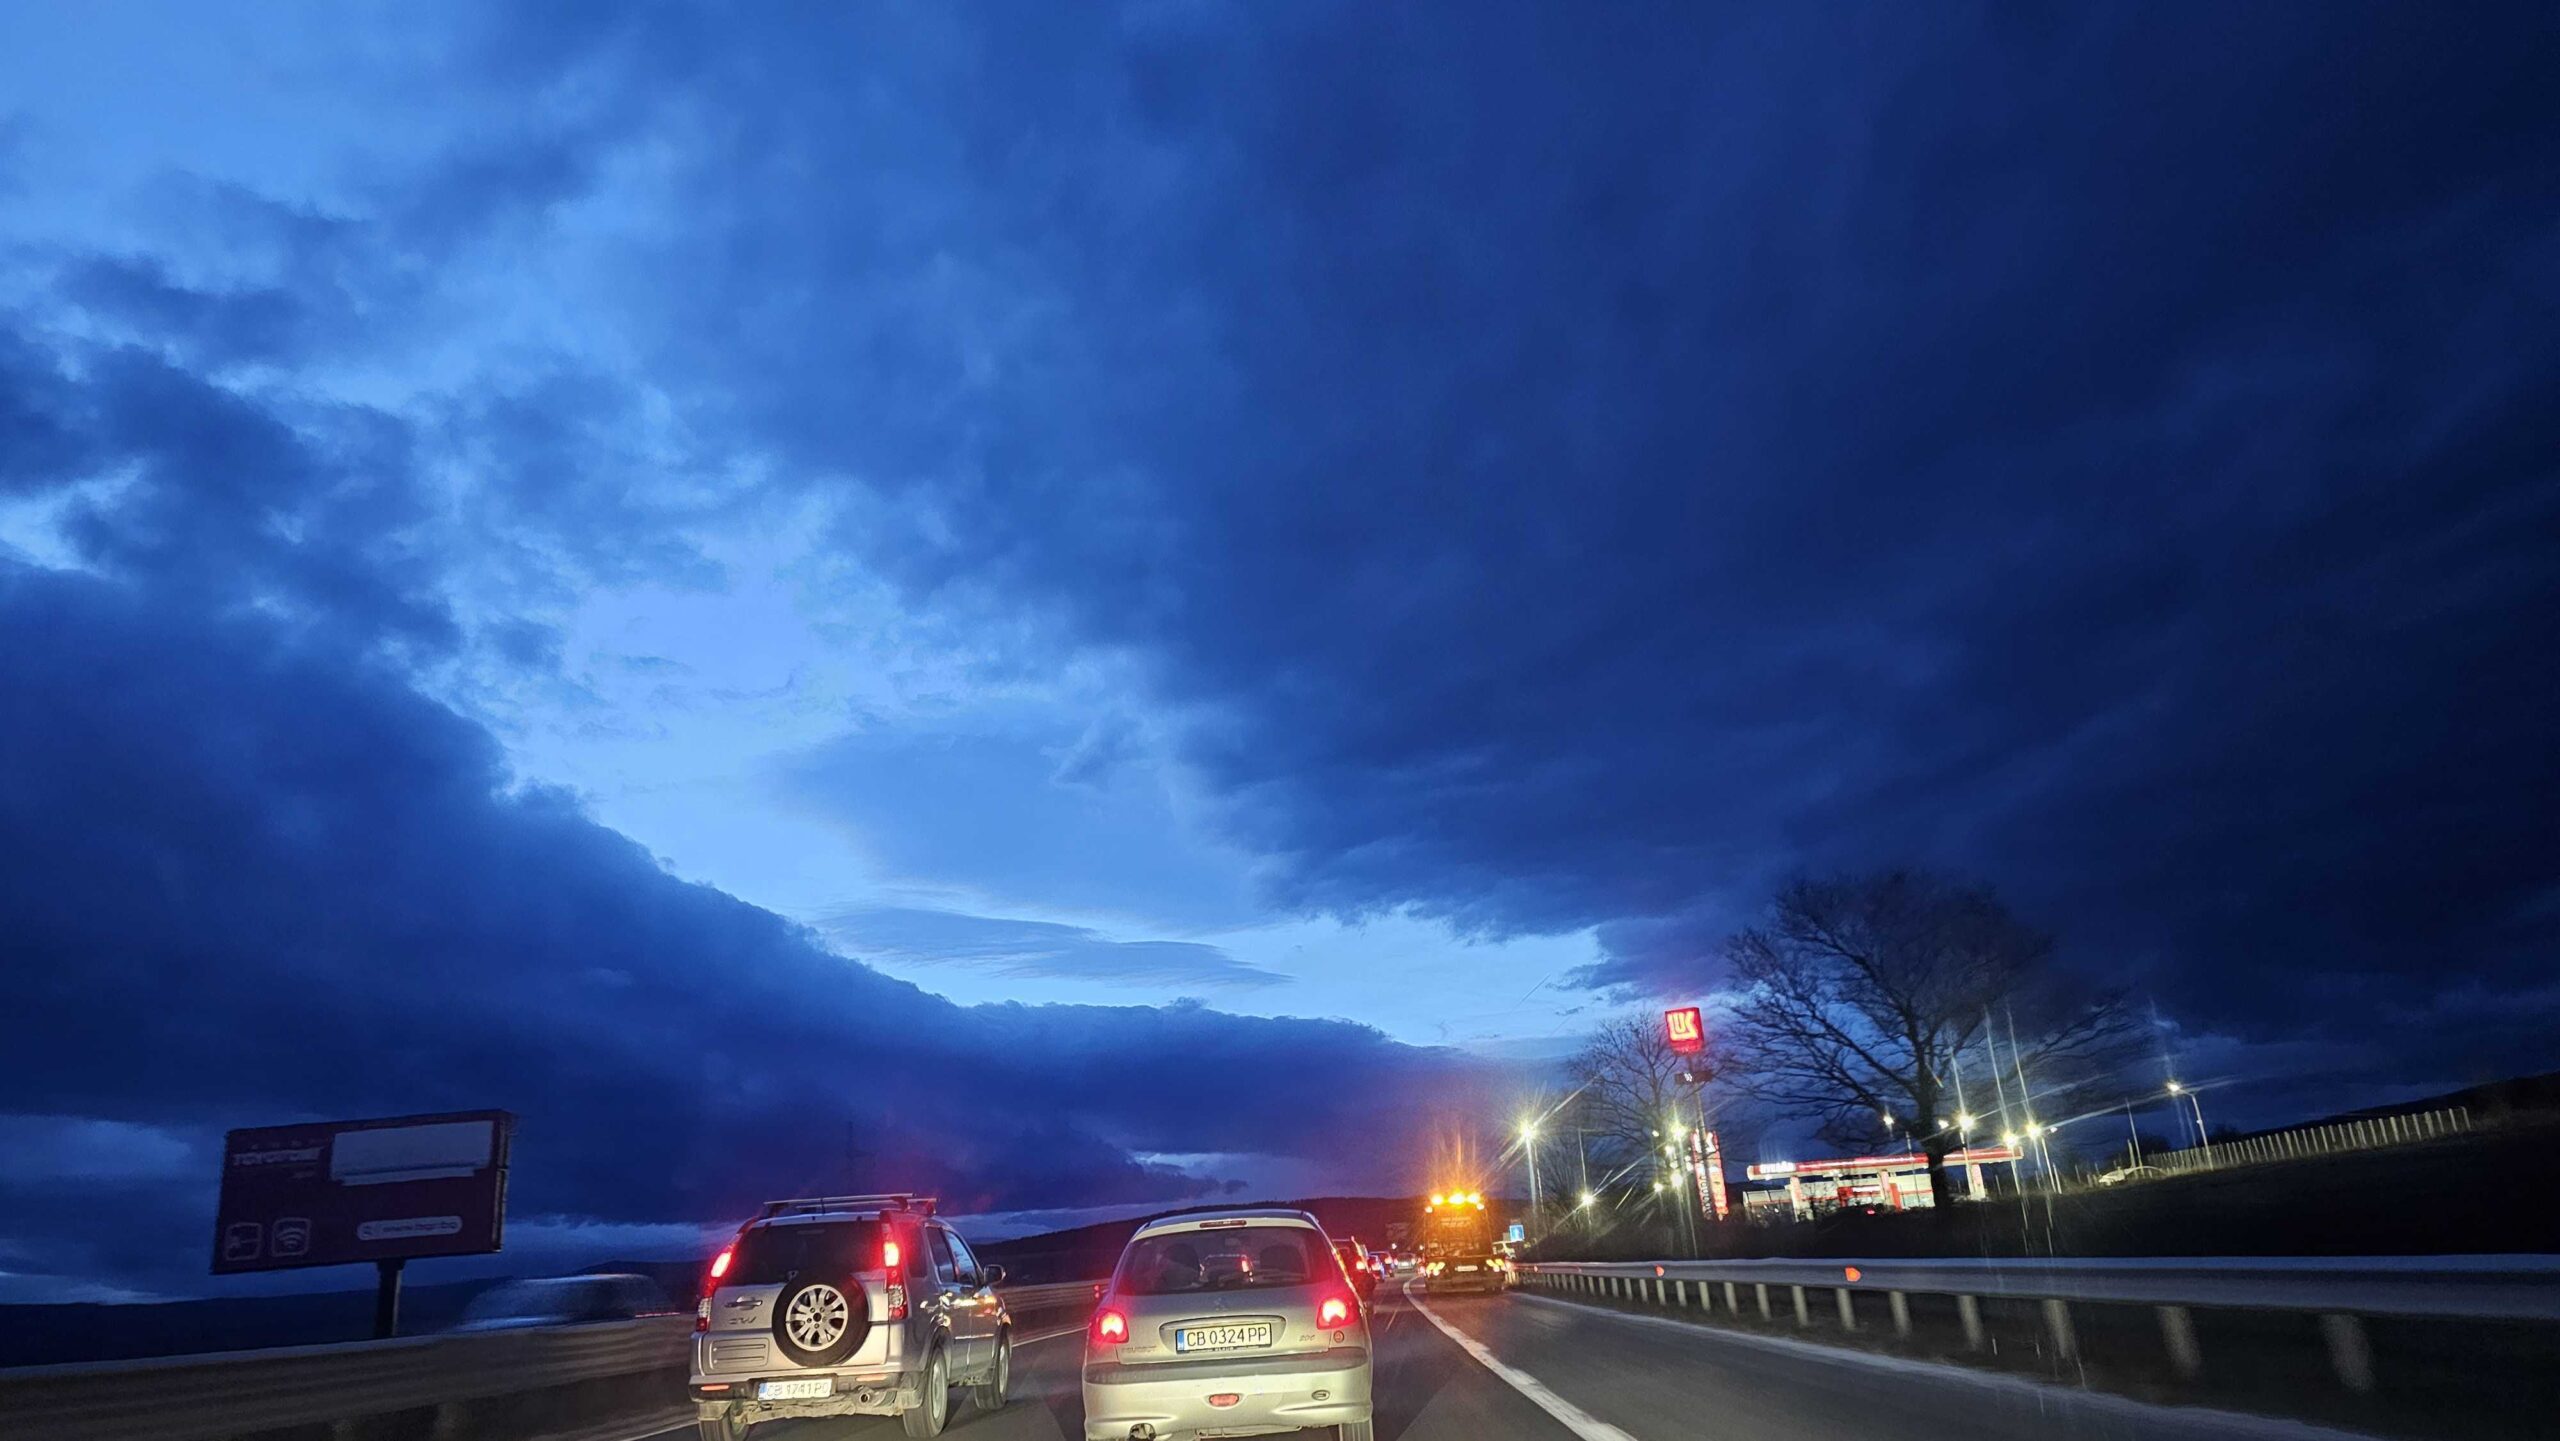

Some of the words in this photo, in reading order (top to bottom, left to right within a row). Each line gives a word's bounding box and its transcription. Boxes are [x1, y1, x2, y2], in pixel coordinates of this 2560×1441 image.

[1187, 1331, 1207, 1347] CB
[1209, 1327, 1245, 1345] 0324
[1248, 1327, 1268, 1342] PP
